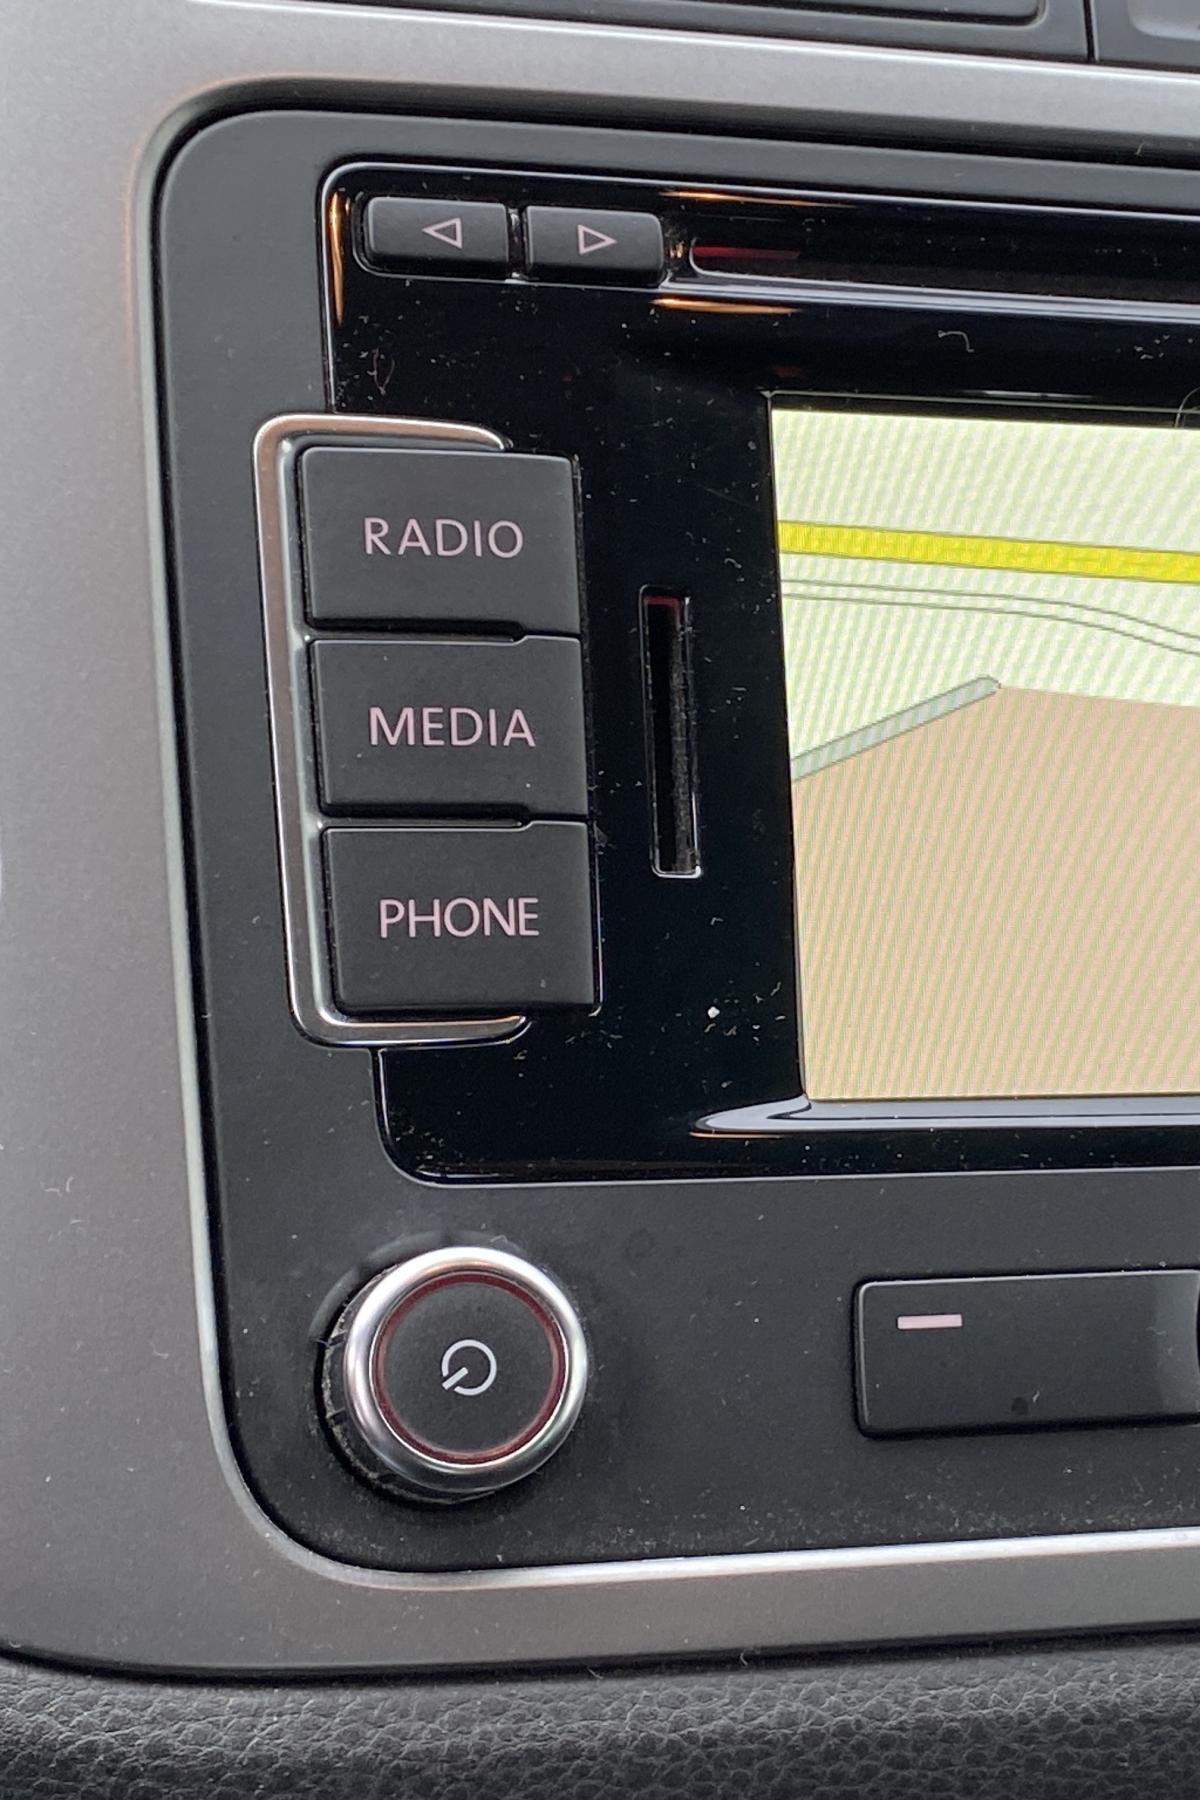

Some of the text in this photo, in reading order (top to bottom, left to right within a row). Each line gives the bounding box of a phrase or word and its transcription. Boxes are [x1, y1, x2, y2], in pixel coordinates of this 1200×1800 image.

[364, 517, 524, 559] RADIO
[369, 706, 536, 747] MEDIA
[379, 898, 540, 938] PHONE
